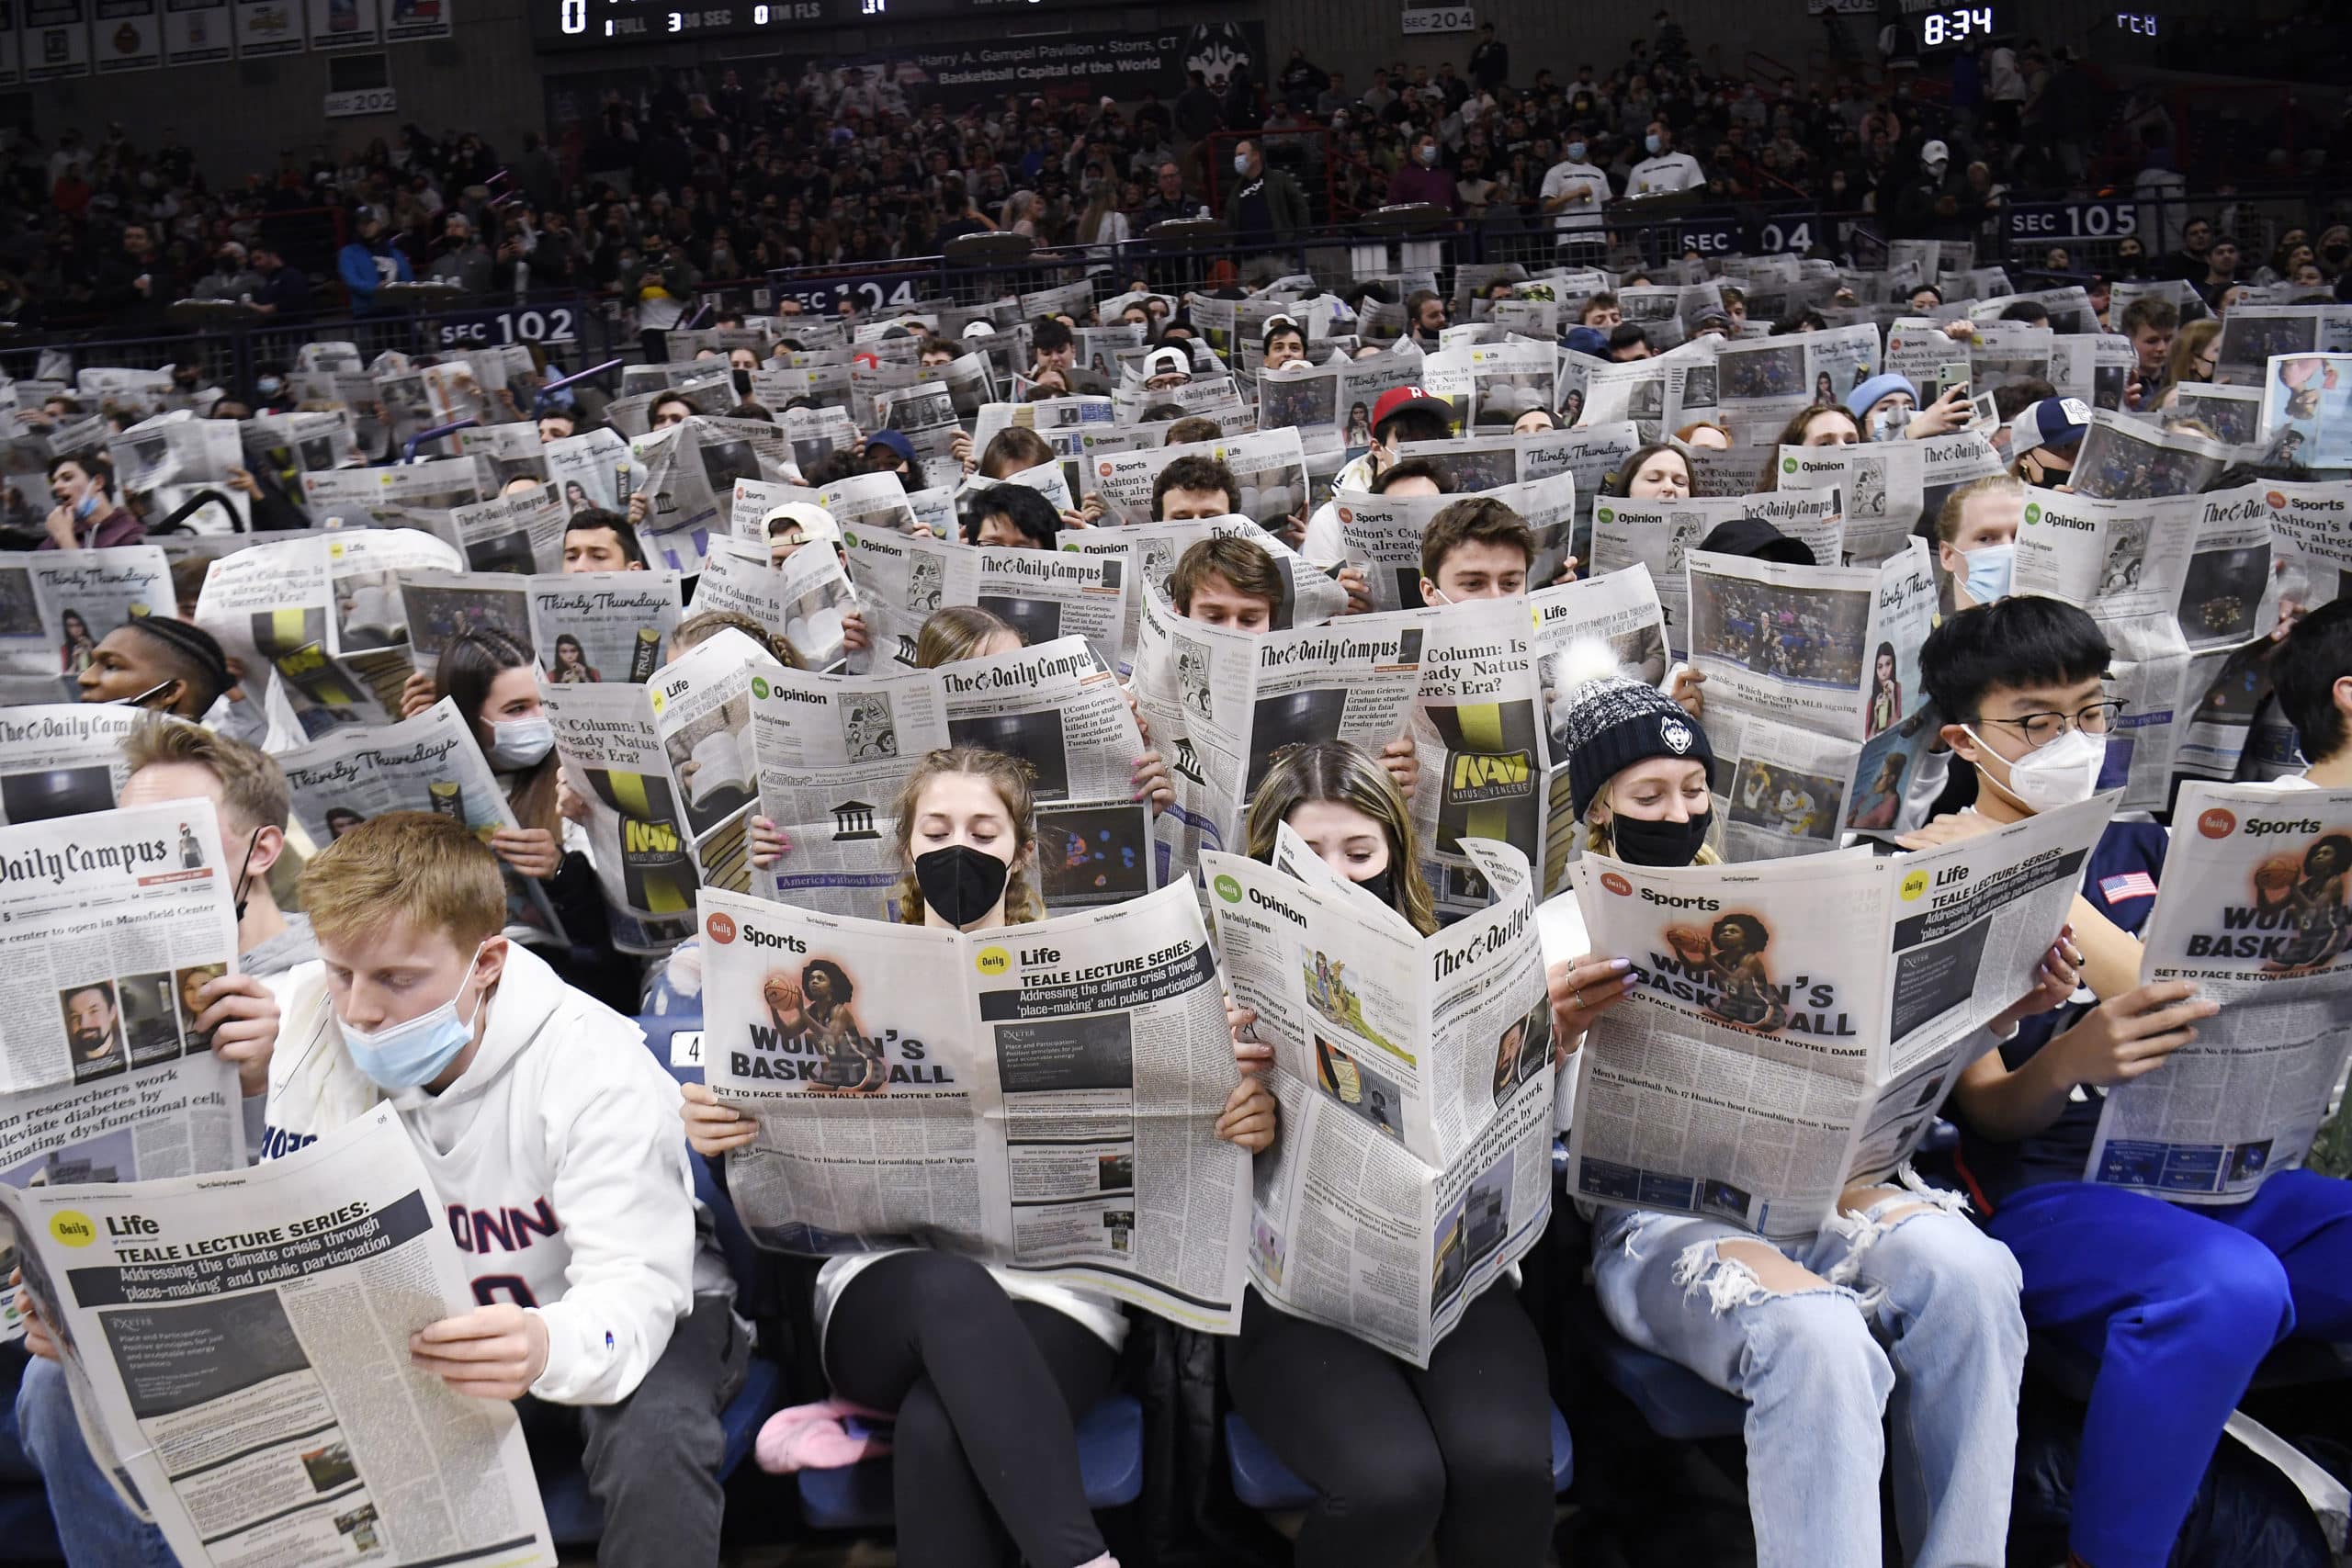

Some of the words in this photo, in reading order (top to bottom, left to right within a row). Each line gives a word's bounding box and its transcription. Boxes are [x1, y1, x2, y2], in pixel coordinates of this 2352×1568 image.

[704, 9, 732, 27] SEC
[753, 5, 768, 25] 0
[795, 3, 820, 19] FLS
[1431, 12, 1471, 28] 204
[1925, 7, 1992, 45] 8:34
[919, 53, 957, 66] Harry
[963, 51, 977, 63] A.
[980, 47, 1035, 62] Gampel
[1040, 44, 1094, 57] Pavilion
[1110, 39, 1154, 53] Storrs,
[1158, 37, 1178, 49] CT
[939, 67, 1013, 85] Basketball
[1017, 63, 1068, 80] Capital
[1072, 62, 1086, 73] of
[1090, 60, 1114, 73] the
[1117, 57, 1160, 72] World
[354, 93, 395, 111] 202
[2011, 212, 2055, 233] SEC
[2065, 205, 2137, 237] 105
[1683, 231, 1729, 252] SEC
[1736, 221, 1814, 253] 04
[440, 321, 486, 344] SEC
[495, 307, 574, 344] 102
[1116, 461, 1147, 472] Sports
[1802, 460, 1845, 473] Opinion
[1102, 474, 1147, 489] Ashton's
[2291, 498, 2345, 512] Sports
[1356, 513, 1393, 523] Sports
[1619, 513, 1662, 525] Opinion
[2045, 512, 2096, 532] Opinion
[2268, 511, 2340, 533] Ashton's
[861, 538, 902, 558] Opinion
[1084, 543, 1128, 554] Opinion
[1544, 604, 1567, 620] Life
[1261, 645, 1286, 667] The
[1299, 639, 1338, 665] Daily
[1340, 637, 1397, 663] Campus
[1428, 645, 1502, 663] Column:
[1510, 638, 1527, 653] Is
[943, 674, 973, 693] The
[992, 662, 1036, 688] Daily
[1037, 650, 1091, 677] Campus
[666, 678, 690, 699] Life
[773, 685, 827, 705] Opinion
[1737, 693, 1753, 701] was
[1737, 682, 1762, 697] Which
[1802, 699, 1823, 708] MLB
[1824, 704, 1858, 715] signing
[1064, 710, 1100, 723] Graduate
[1102, 702, 1124, 714] student
[1066, 720, 1088, 731] killed
[1090, 719, 1097, 728] in
[1100, 715, 1115, 726] fatal
[570, 718, 636, 734] Column:
[639, 720, 655, 735] Is
[1068, 737, 1101, 747] Tuesday
[1102, 733, 1123, 745] night
[609, 748, 640, 764] Era?
[1453, 789, 1477, 799] NATUS
[1490, 784, 1528, 795] VINCERE
[2204, 816, 2229, 831] Daily
[2244, 818, 2322, 837] Sports
[1905, 880, 1923, 893] Daily
[1936, 865, 1969, 887] Life
[1932, 886, 1970, 909] TEALE
[1973, 863, 2020, 895] LECTURE
[2021, 847, 2064, 870] SERIES:
[1217, 880, 1238, 897] Daily
[1248, 887, 1307, 929] Opinion
[1641, 886, 1720, 911] Sports
[9, 930, 48, 942] center
[51, 927, 64, 935] to
[68, 921, 98, 935] open
[101, 918, 113, 928] in
[117, 908, 175, 926] Mansfield
[178, 903, 216, 917] Center
[712, 921, 731, 936] Daily
[743, 924, 807, 954] Sports
[1433, 949, 1465, 982] The
[1487, 908, 1523, 953] Daily
[982, 955, 1004, 967] Daily
[1020, 947, 1061, 966] Life
[1021, 970, 1071, 987] TEALE
[1076, 957, 1145, 981] LECTURE
[1148, 940, 1193, 965] SERIES:
[1020, 986, 1079, 1002] Addressing
[1080, 982, 1099, 996] the
[1102, 976, 1138, 992] climate
[1140, 968, 1167, 986] crisis
[1169, 955, 1198, 979] through
[2154, 968, 2177, 977] SET
[2181, 969, 2199, 978] TO
[2200, 970, 2232, 979] FACE
[2235, 972, 2277, 982] SETON
[1098, 996, 1117, 1010] and
[1119, 988, 1149, 1007] public
[1151, 970, 1204, 999] participation
[1233, 983, 1252, 992] Free
[1253, 987, 1287, 1015] emergency
[1236, 994, 1280, 1019] contraception
[1282, 1017, 1305, 1034] makes
[1283, 1026, 1306, 1046] UConn
[1649, 996, 1677, 1012] FACE
[1679, 1010, 1719, 1027] SETON
[1721, 1021, 1753, 1036] HALL
[1755, 1032, 1781, 1043] AND
[1784, 1040, 1827, 1054] NOTRE
[1831, 1047, 1868, 1057] DAME
[689, 1036, 700, 1063] 4
[730, 1051, 955, 1084] BASKALL
[26, 1084, 130, 1122] researchers
[136, 1068, 179, 1089] work
[712, 1084, 730, 1097] SET
[734, 1089, 750, 1098] TO
[1592, 1067, 1616, 1081] Men's
[1617, 1072, 1663, 1094] Basketball:
[1664, 1084, 1681, 1097] No.
[1681, 1089, 1690, 1100] 17
[1691, 1091, 1726, 1109] Huskies
[1727, 1100, 1747, 1112] host
[1747, 1106, 1795, 1125] Grambling
[1796, 1117, 1819, 1128] State
[1822, 1121, 1850, 1133] Tigers
[59, 1221, 90, 1237] Daily
[107, 1214, 160, 1235] Life
[115, 1239, 183, 1264] TEALE
[186, 1225, 286, 1256] LECTURE
[289, 1201, 370, 1238] SERIES:
[120, 1260, 197, 1282] Addressing
[198, 1257, 224, 1273] the
[227, 1249, 278, 1269] climate
[282, 1237, 321, 1260] crisis
[323, 1217, 380, 1248] through
[226, 1269, 254, 1288] and
[257, 1259, 300, 1286] public
[301, 1233, 391, 1277] participation
